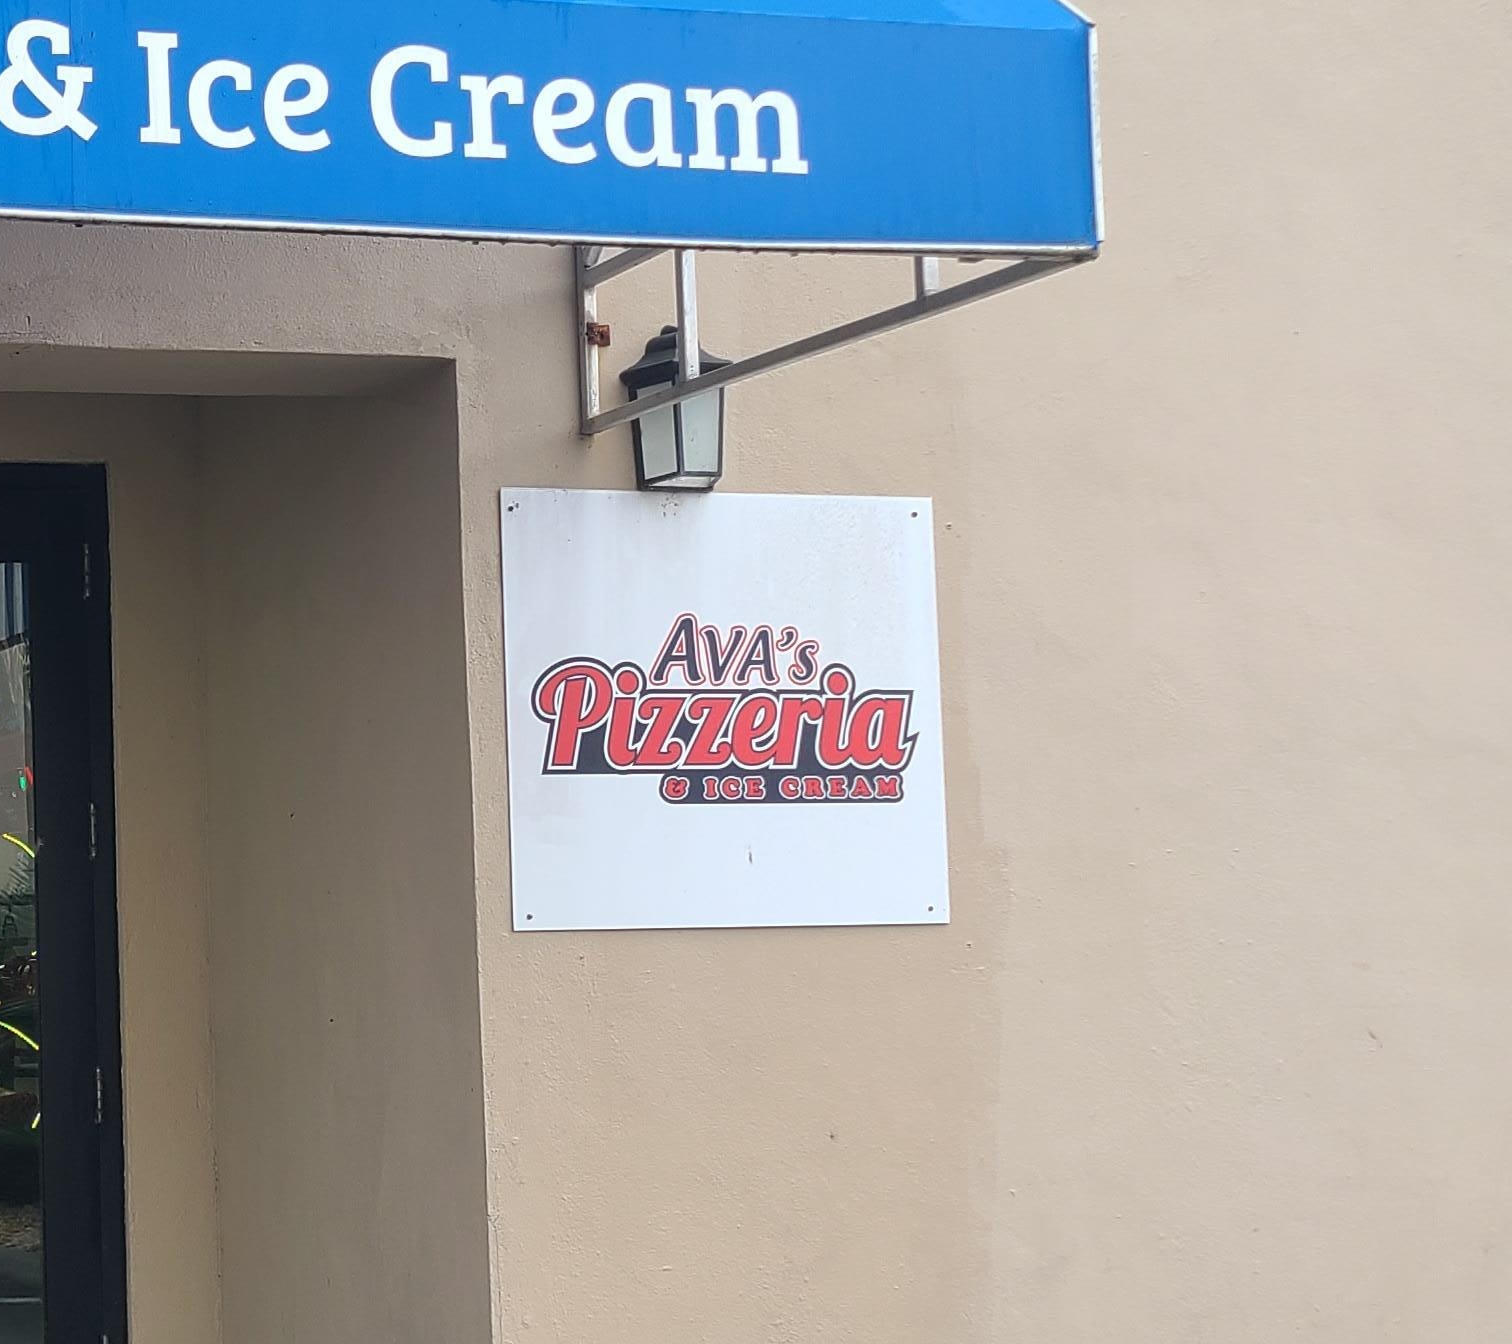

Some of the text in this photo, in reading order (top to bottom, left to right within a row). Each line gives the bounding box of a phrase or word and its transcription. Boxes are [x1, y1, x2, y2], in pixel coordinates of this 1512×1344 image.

[138, 32, 330, 151] Ice
[371, 45, 808, 174] Cream
[534, 659, 912, 771] Pizzeria
[662, 775, 904, 801] & ICE CREAM
